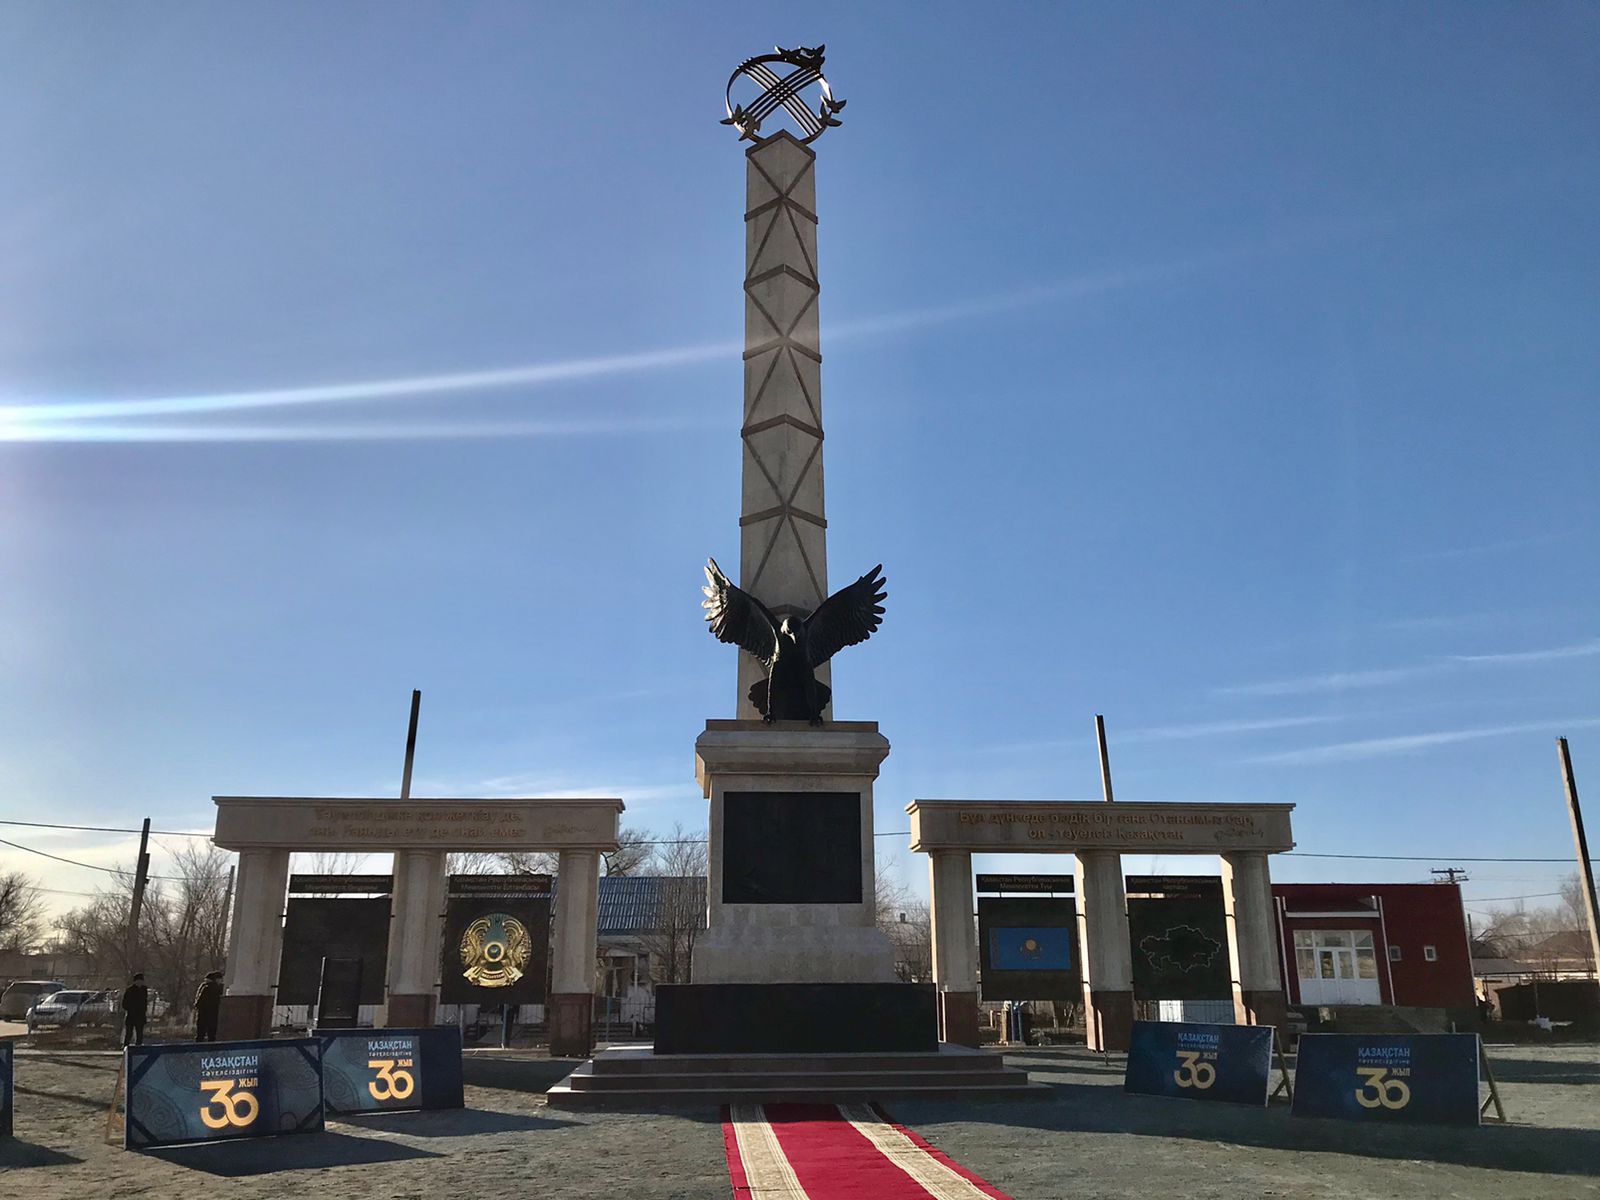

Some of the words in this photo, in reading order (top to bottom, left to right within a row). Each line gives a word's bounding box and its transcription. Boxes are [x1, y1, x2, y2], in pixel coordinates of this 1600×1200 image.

[368, 1040, 412, 1051] ҚАЗАҚСТАН
[1178, 1033, 1219, 1043] ҚАЗАҚСТАН
[201, 1056, 258, 1069] ҚАЗАҚСТАН
[1358, 1047, 1410, 1058] ҚАЗАҚСТАН
[368, 1060, 414, 1100] 30
[1174, 1051, 1216, 1089] 30
[1356, 1068, 1411, 1109] 30
[1391, 1068, 1410, 1076] ЖЫЛ
[200, 1079, 259, 1128] 30
[238, 1077, 258, 1088] ЖЫЛ
